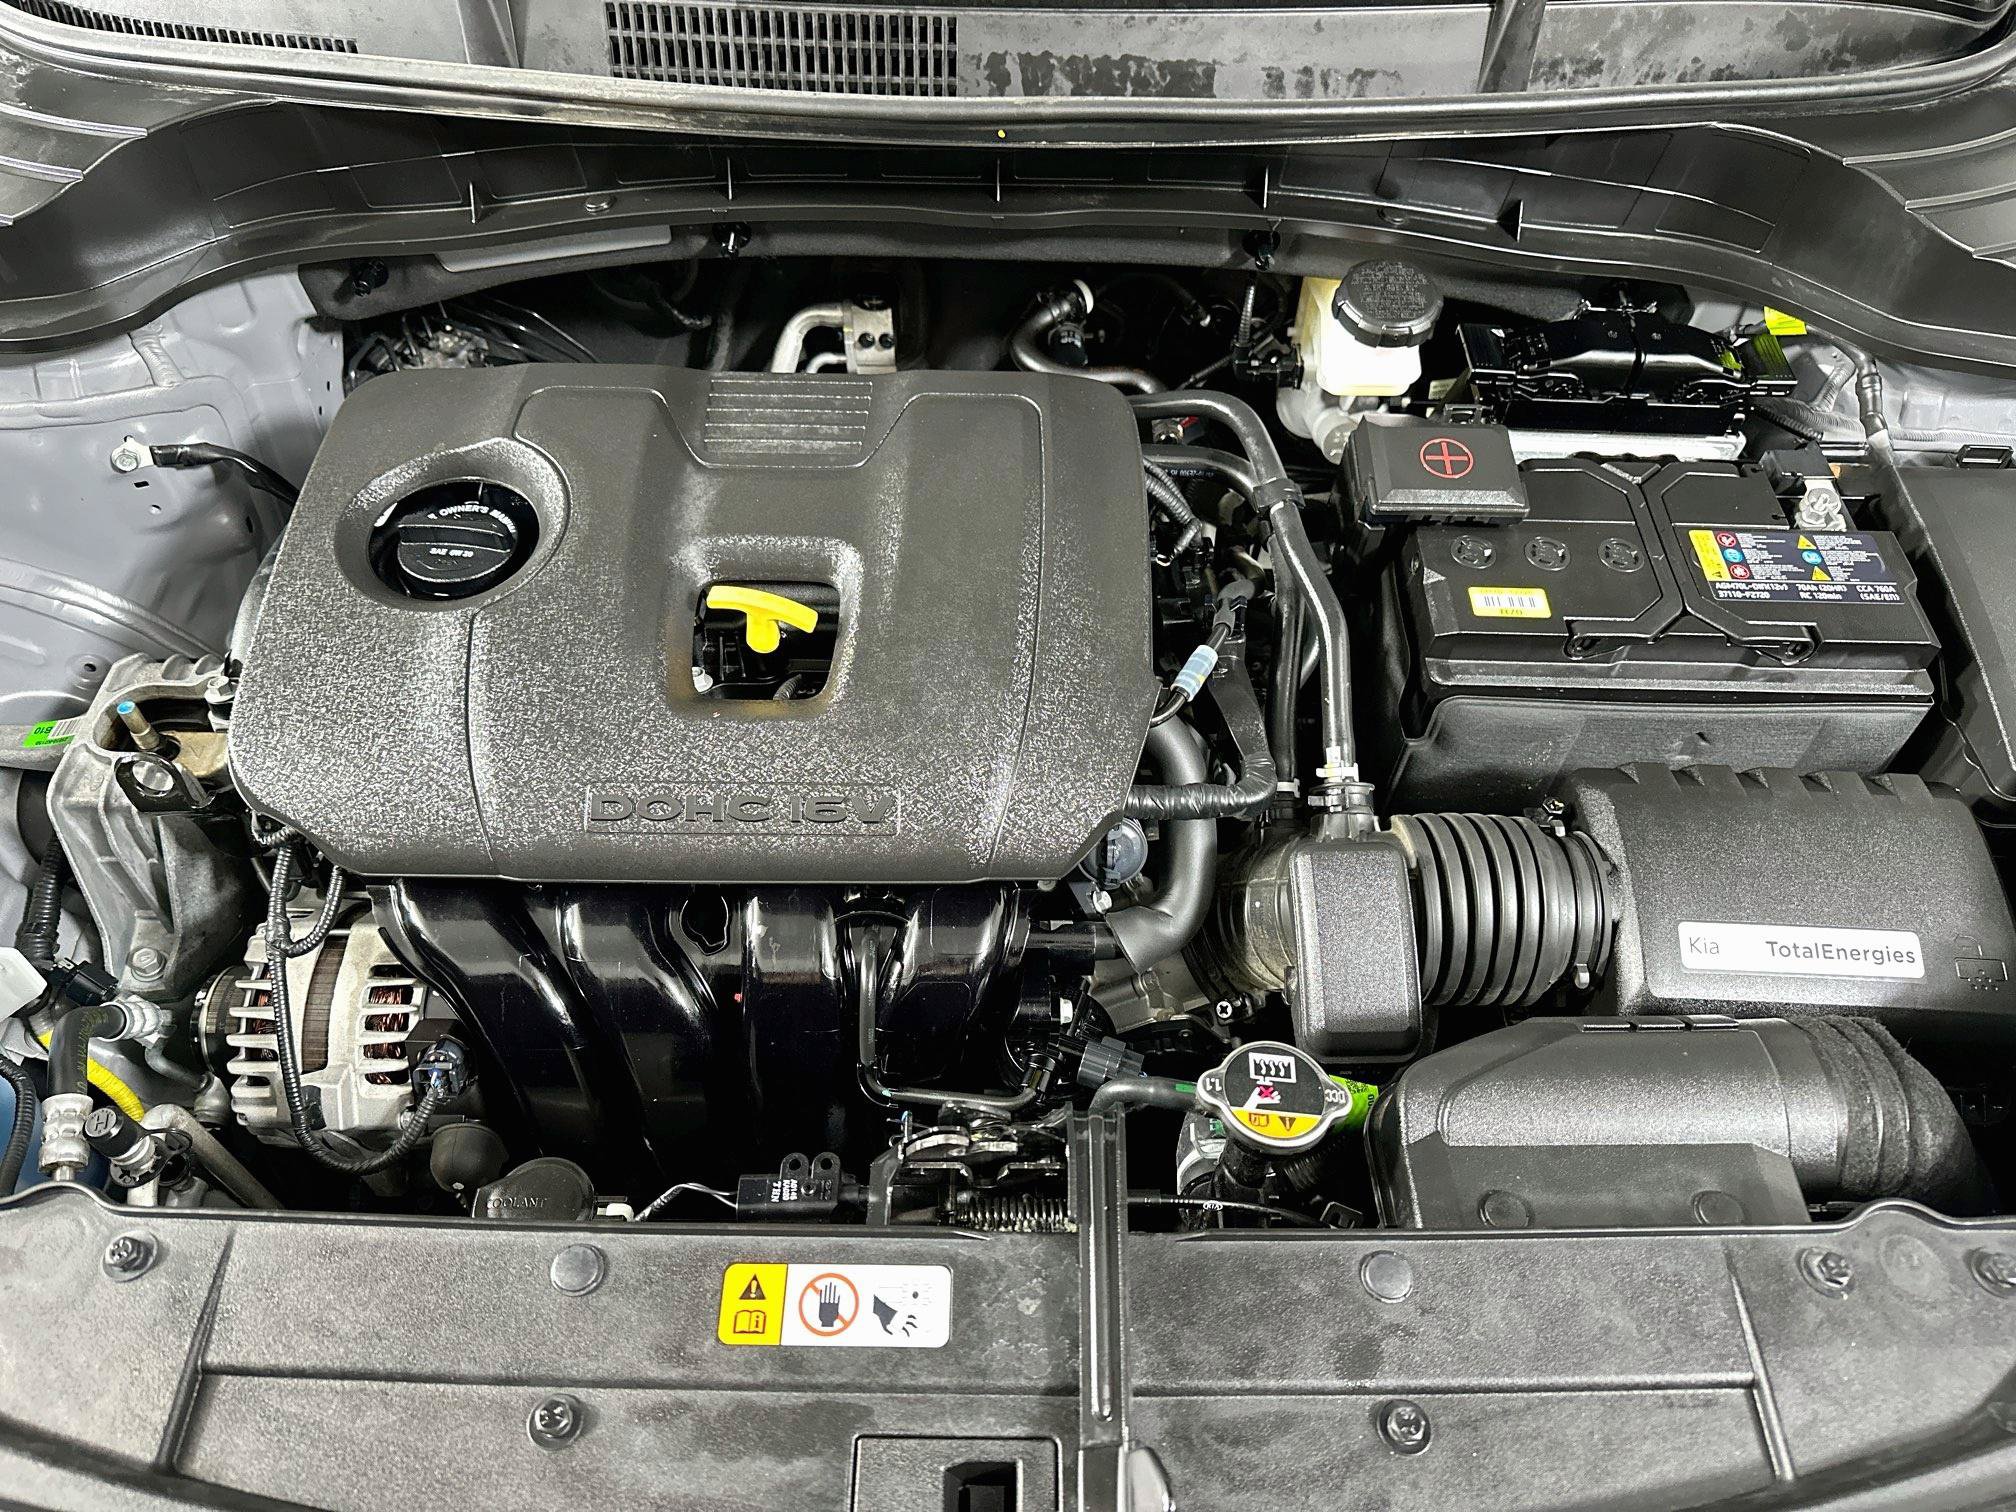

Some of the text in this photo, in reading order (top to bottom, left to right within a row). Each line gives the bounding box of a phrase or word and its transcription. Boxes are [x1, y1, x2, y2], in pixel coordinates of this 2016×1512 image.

[439, 505, 489, 516] OWNER'S
[590, 795, 894, 823] DOHC 16V
[1689, 936, 1916, 966] Kia TotalEnergies
[771, 1180, 782, 1203] THN
